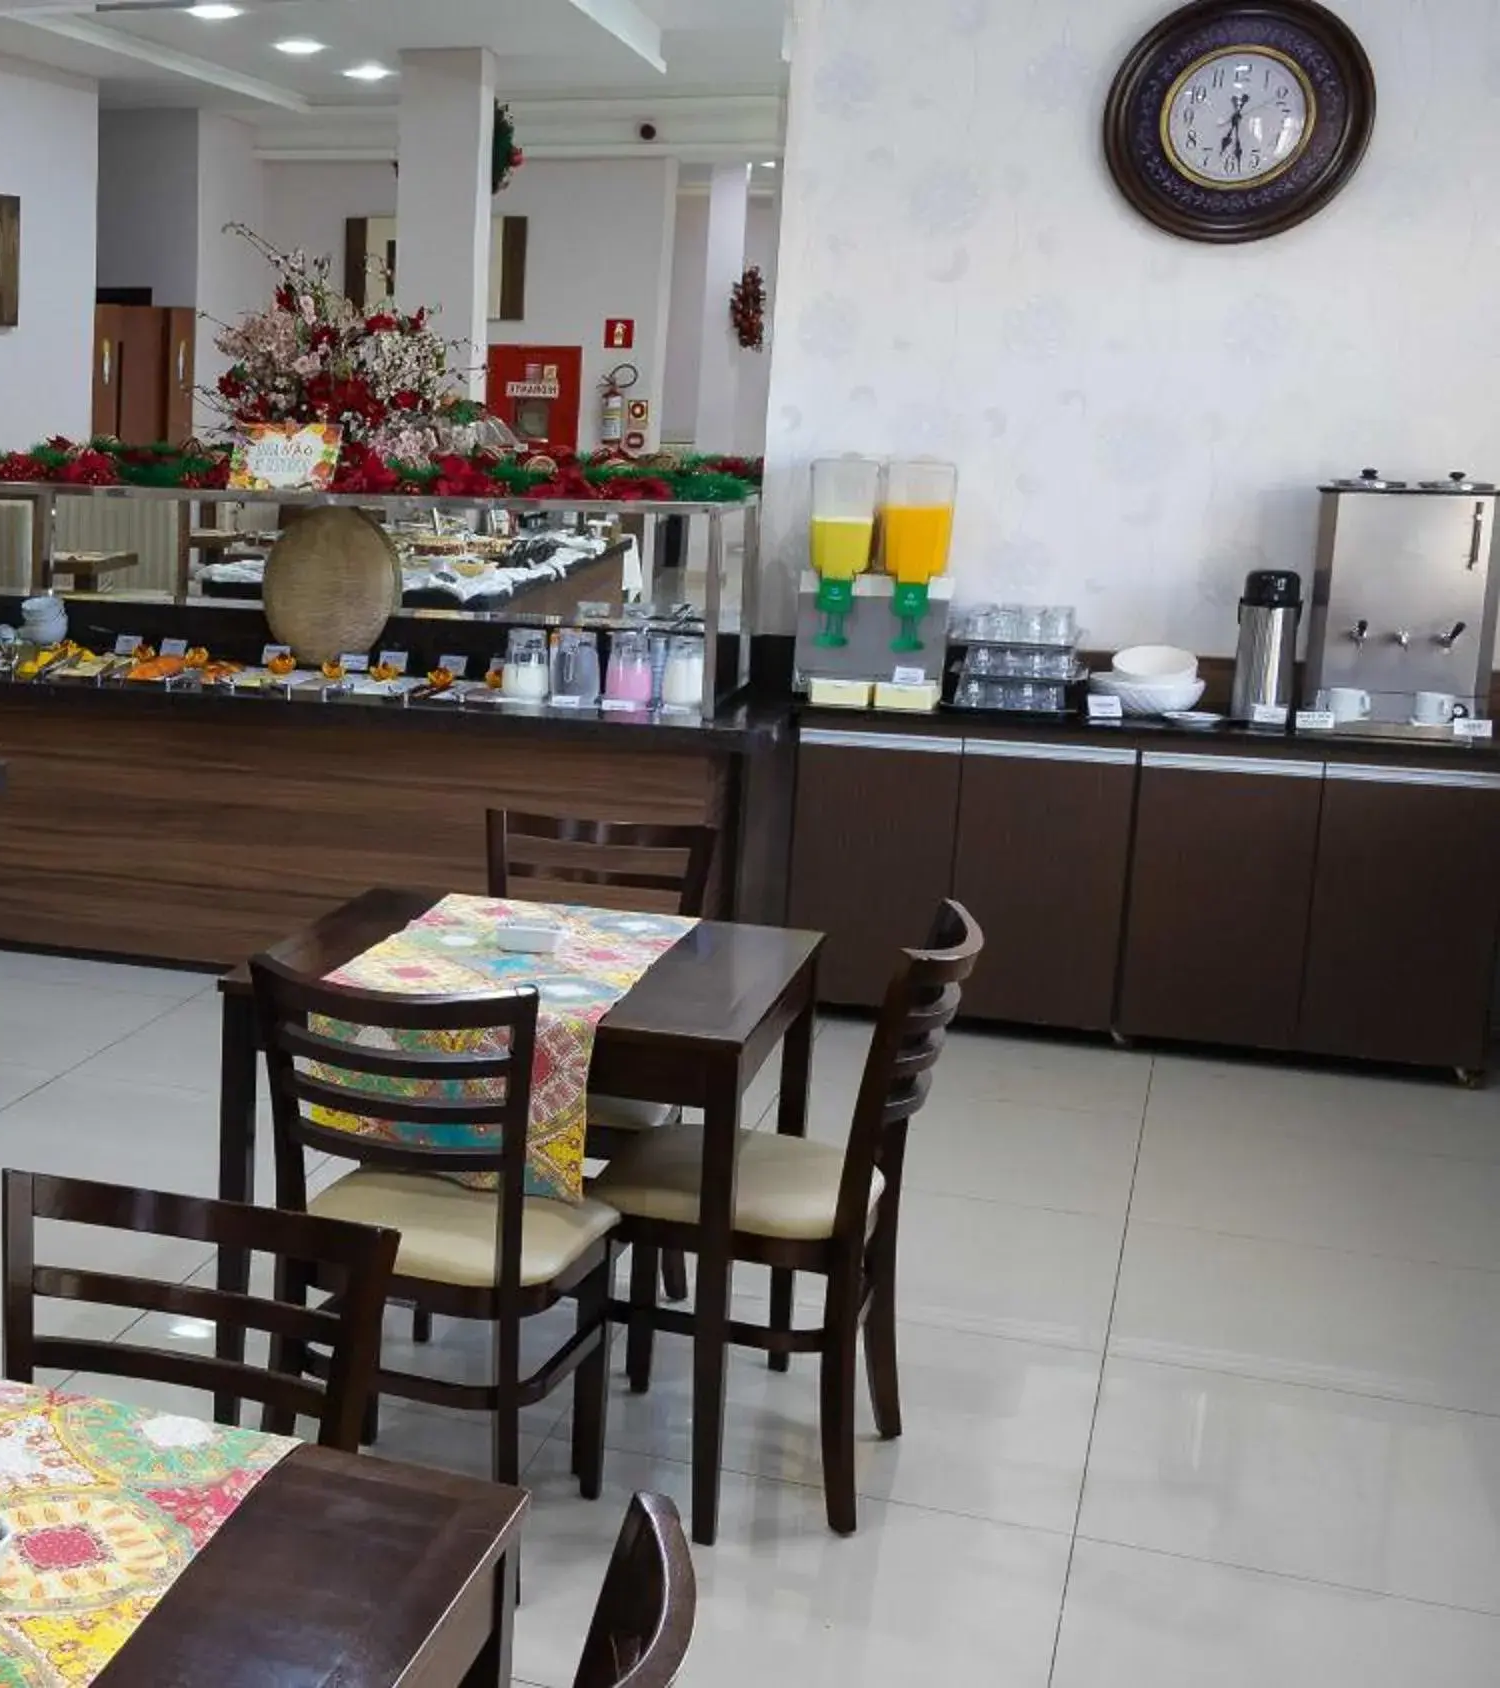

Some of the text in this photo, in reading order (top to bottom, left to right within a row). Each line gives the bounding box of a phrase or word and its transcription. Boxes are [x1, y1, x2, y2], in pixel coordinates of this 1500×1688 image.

[1212, 67, 1225, 89] 11
[1189, 85, 1207, 105] 10
[1183, 107, 1195, 125] 9
[1185, 129, 1198, 149] 8
